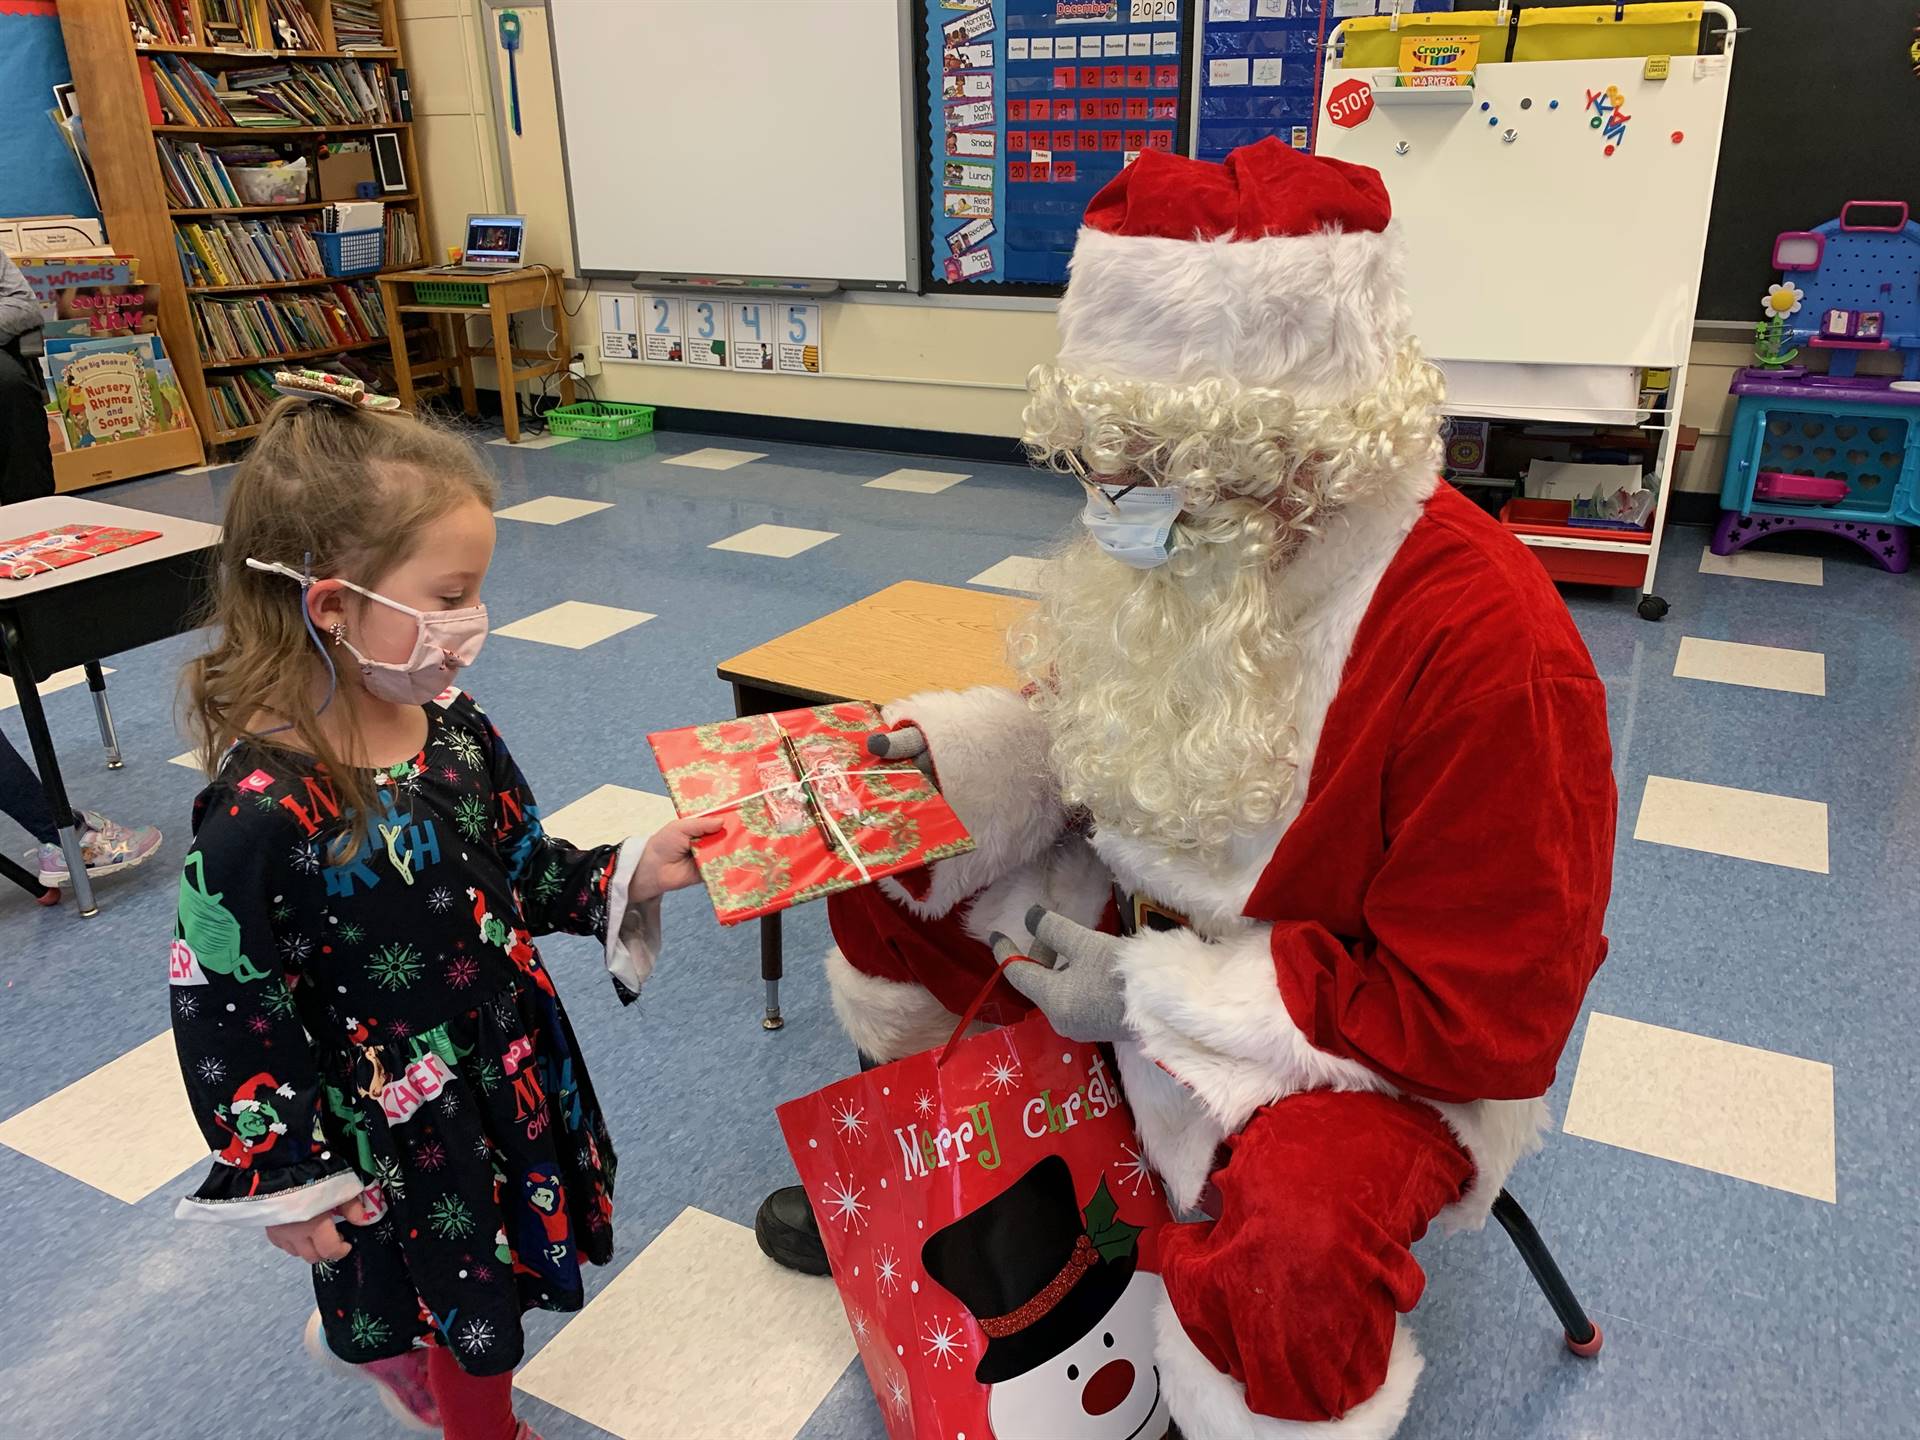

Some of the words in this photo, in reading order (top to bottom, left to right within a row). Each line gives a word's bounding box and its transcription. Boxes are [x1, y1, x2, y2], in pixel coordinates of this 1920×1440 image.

[1057, 3, 1109, 15] December
[1132, 2, 1176, 16] 2020
[963, 12, 990, 27] Morning
[966, 19, 992, 34] Meeting
[1417, 45, 1460, 55] Crayola
[1062, 72, 1068, 83] 1
[1087, 72, 1095, 84] 2
[1111, 71, 1118, 84] 3
[1134, 71, 1142, 83] 4
[1161, 70, 1170, 83] 5
[1412, 76, 1457, 87] MARKERS
[976, 82, 990, 90] ELA
[973, 103, 991, 113] Daily
[1013, 104, 1020, 116] 6
[1036, 104, 1044, 116] 7
[1086, 103, 1094, 115] 9
[1105, 102, 1119, 115] 10
[1131, 103, 1143, 115] 11
[1330, 86, 1370, 120] STOP
[973, 112, 992, 122] Math
[971, 139, 992, 148] Snack
[1011, 136, 1023, 148] 13
[1032, 136, 1045, 148] 14
[1056, 135, 1071, 148] 15
[1082, 135, 1095, 147] 16
[1105, 135, 1118, 147] 17
[1128, 135, 1142, 147] 18
[1153, 135, 1168, 147] 19
[969, 171, 992, 181] Lunch
[1012, 166, 1024, 178] 20
[1033, 166, 1047, 178] 21
[1057, 166, 1072, 178] 22
[974, 197, 990, 205] Rest
[973, 205, 991, 214] Time
[967, 220, 991, 238] Recess
[971, 252, 988, 262] Pack
[980, 260, 990, 269] Up
[47, 267, 115, 286] Wheels
[71, 294, 145, 311] SOUNDS
[614, 299, 621, 332] 1
[654, 298, 671, 334] 2
[697, 302, 715, 338] 3
[742, 306, 761, 341] 4
[788, 305, 807, 343] 5
[76, 365, 88, 374] The
[88, 360, 101, 369] Big
[85, 383, 132, 399] Nursery
[89, 395, 134, 411] Rhymes
[106, 406, 123, 417] and
[98, 415, 134, 430] Songs
[893, 1101, 1001, 1182] Merry
